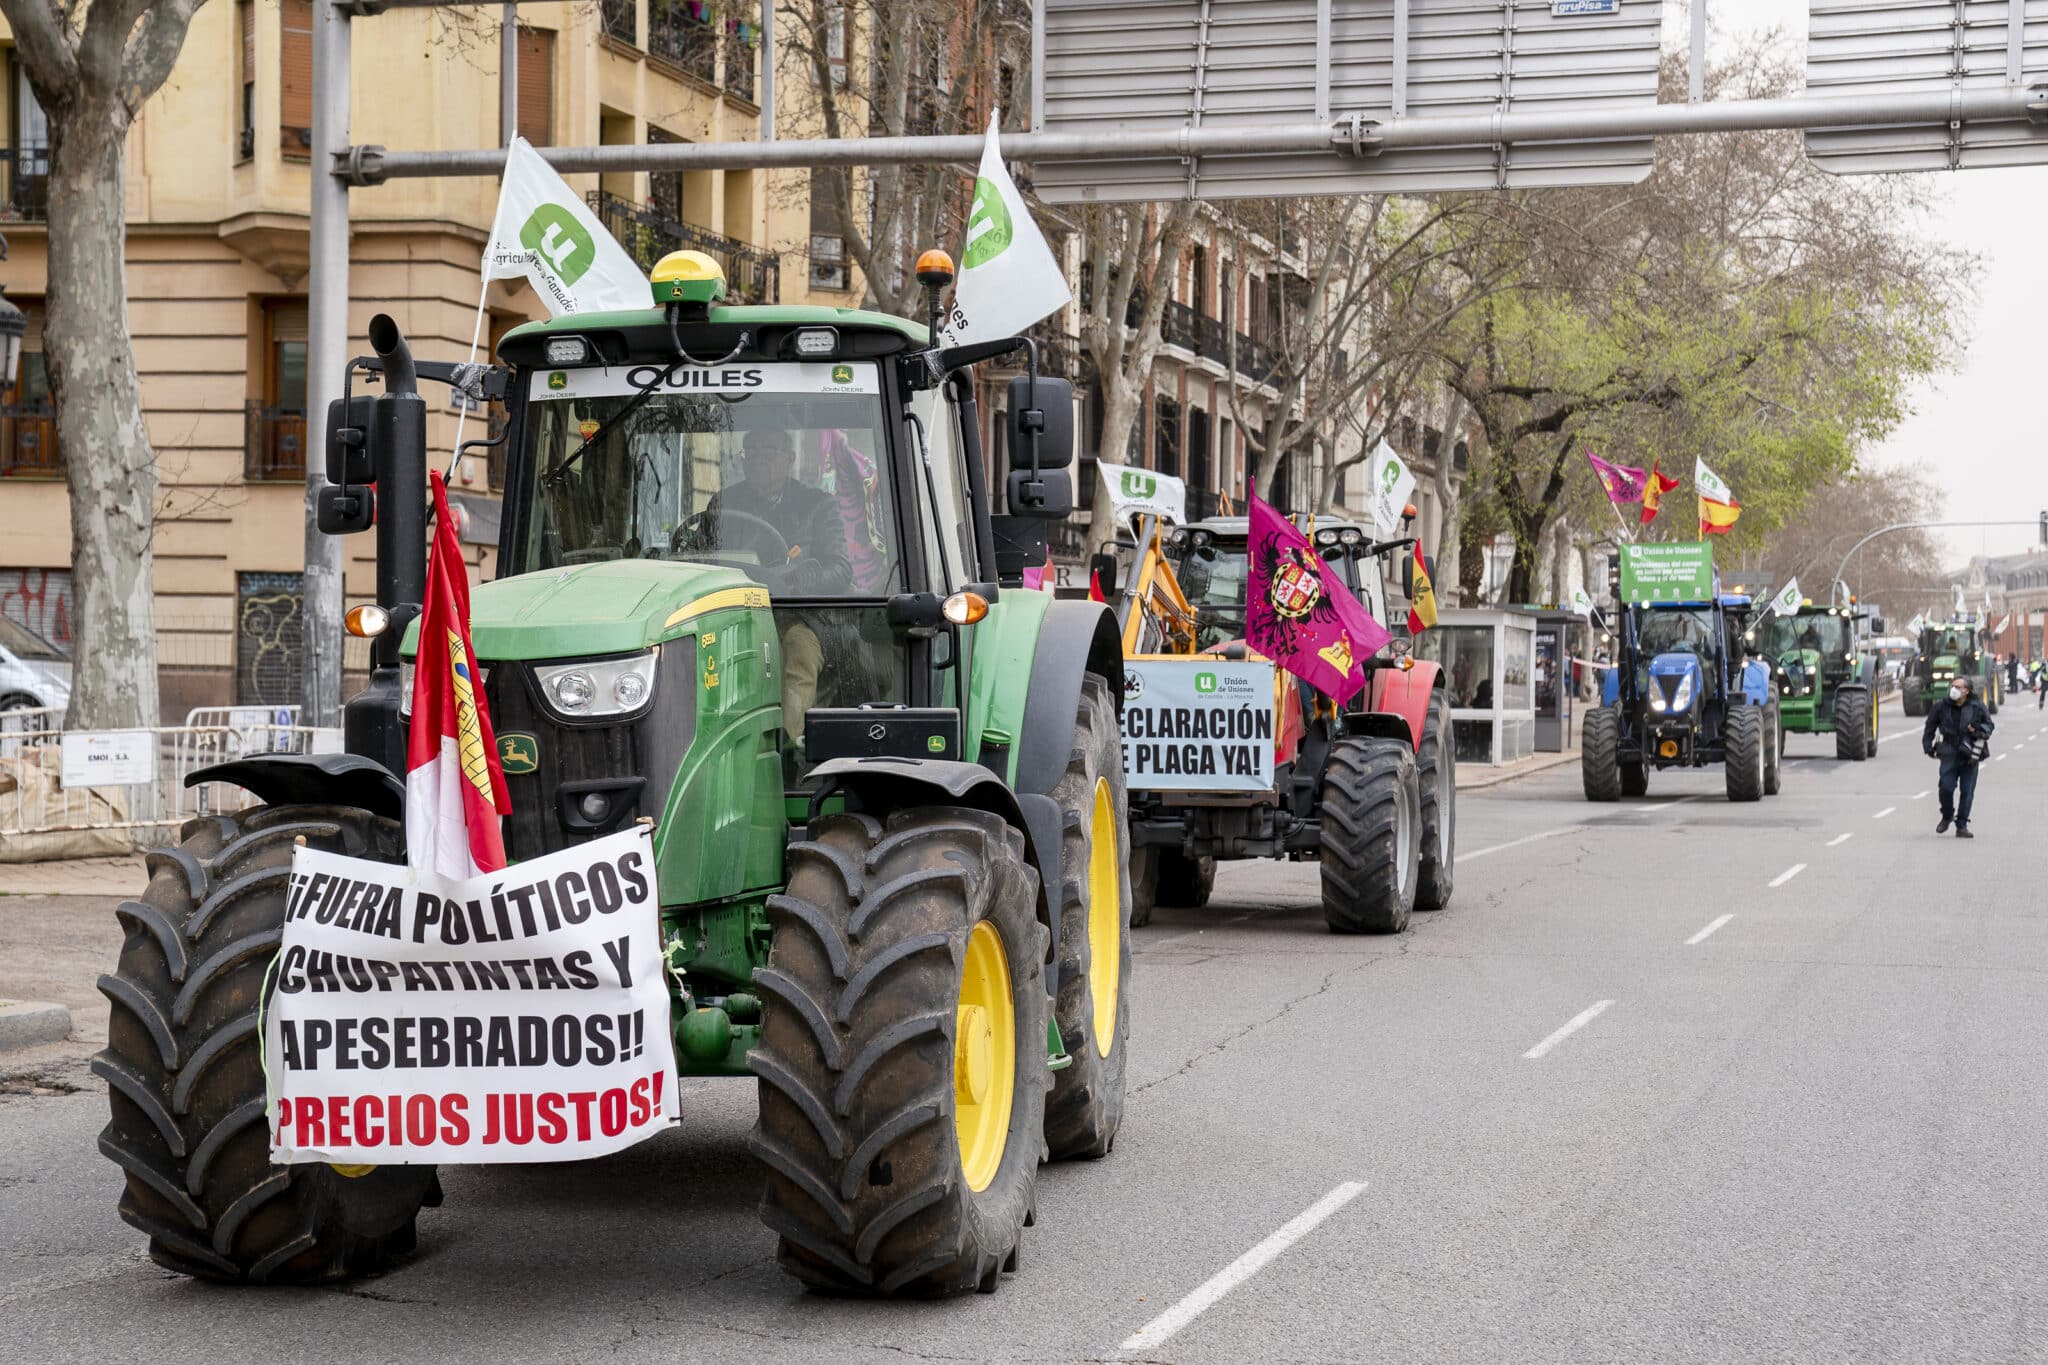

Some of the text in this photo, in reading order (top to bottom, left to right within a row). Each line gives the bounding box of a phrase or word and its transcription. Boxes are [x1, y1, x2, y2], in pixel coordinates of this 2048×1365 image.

[626, 366, 763, 392] QUILES
[1224, 677, 1248, 685] Unión
[1121, 703, 1271, 740] CLARACIÓN
[1136, 744, 1216, 775] PLAGA
[1221, 745, 1260, 776] YA!
[413, 851, 649, 946] POLÍTICOS
[279, 936, 633, 994] CHUPATINTAS Y
[281, 1008, 645, 1071] APESEBRADOS!!
[276, 1070, 665, 1148] PRECIOS JUSTOS!
